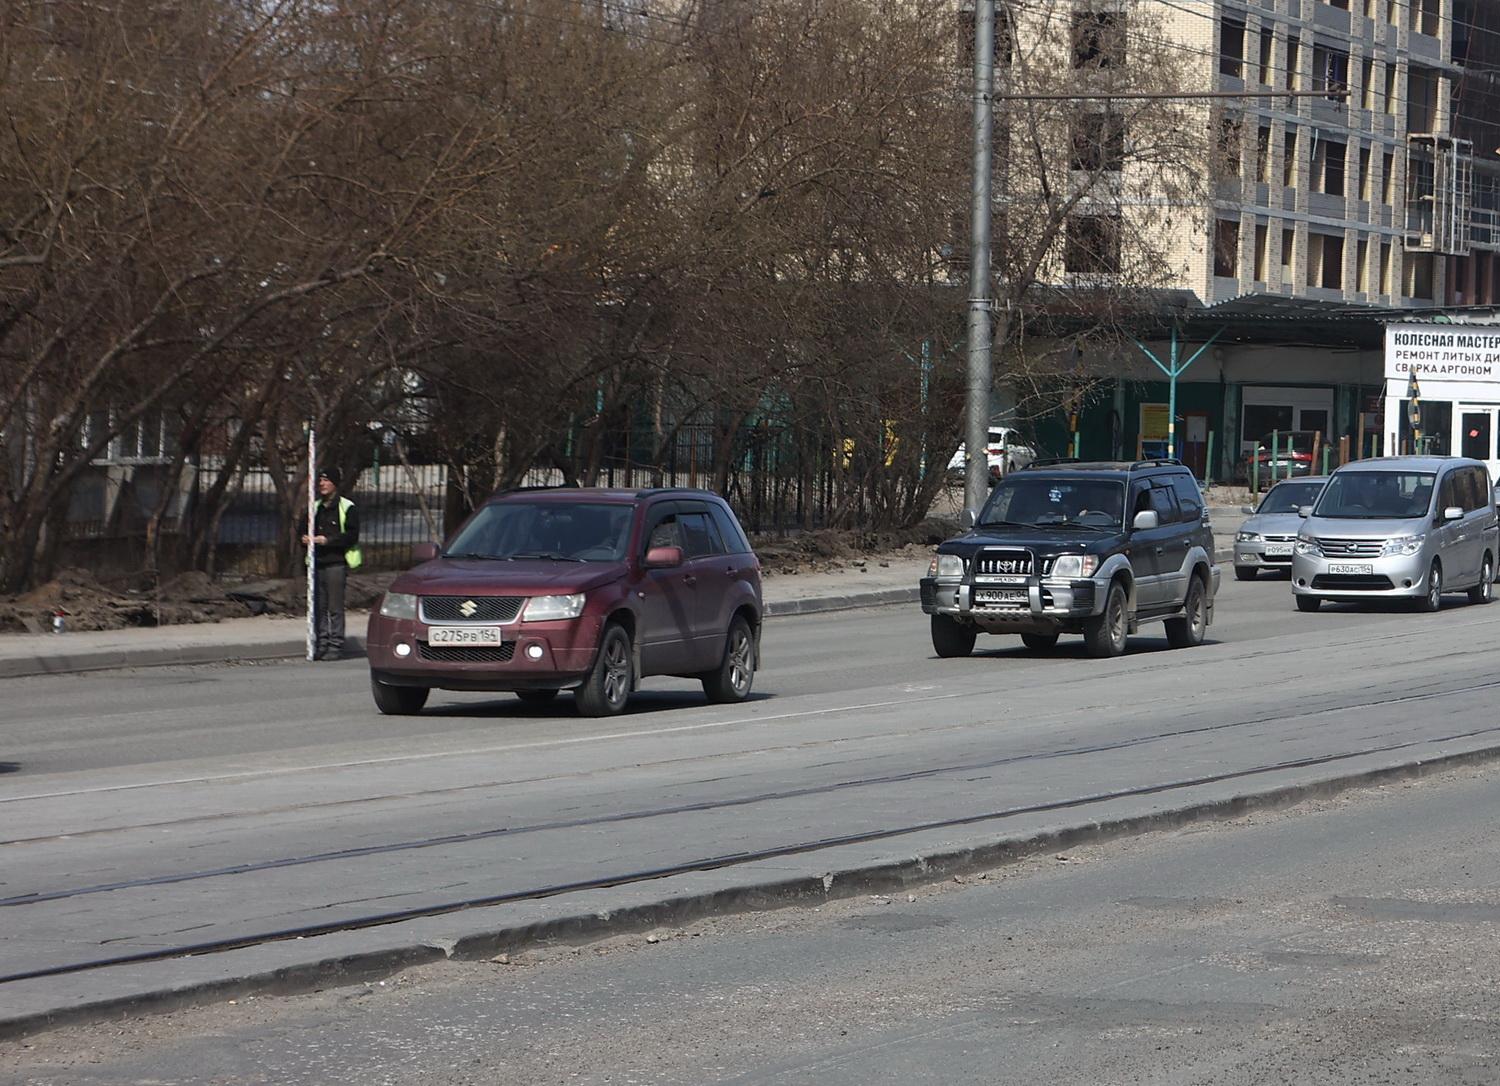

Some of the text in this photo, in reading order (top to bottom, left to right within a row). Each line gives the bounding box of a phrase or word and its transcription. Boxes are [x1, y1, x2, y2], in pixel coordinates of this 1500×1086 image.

[1394, 333, 1454, 348] КОЛЕСНАЯ
[1396, 350, 1440, 360] РЕМОНТ
[1442, 351, 1481, 362] ЛИТЫХ
[1440, 365, 1491, 375] АРГОНОМ
